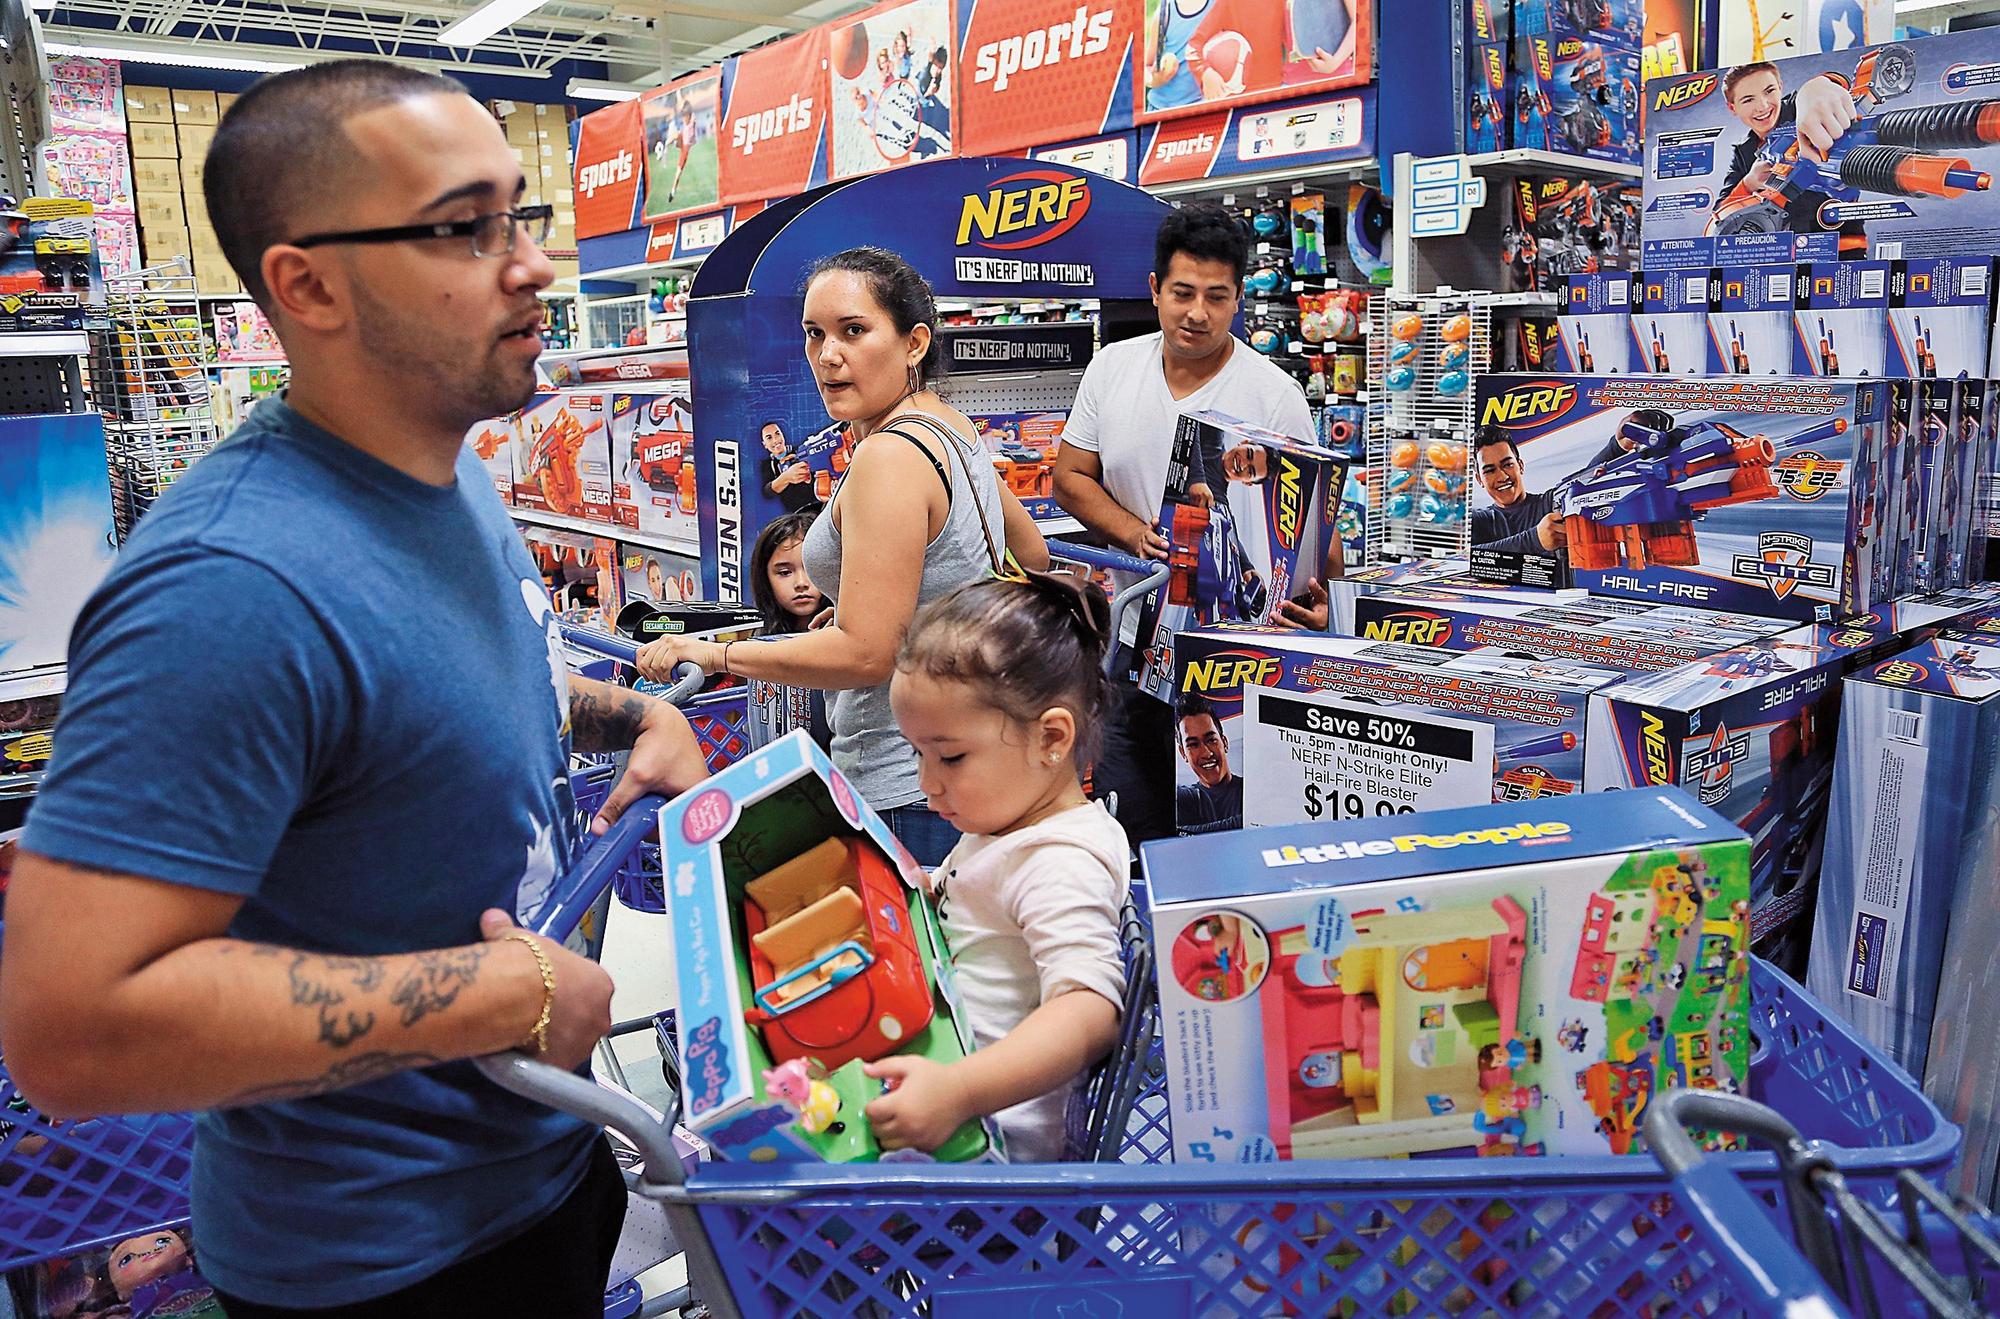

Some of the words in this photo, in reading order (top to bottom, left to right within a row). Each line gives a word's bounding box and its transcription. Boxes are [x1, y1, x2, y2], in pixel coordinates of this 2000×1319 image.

[974, 4, 1113, 92] sports
[1535, 38, 1551, 81] NERF
[1557, 41, 1583, 57] NERF
[1488, 48, 1502, 89] NERF
[1654, 74, 1718, 111] NERF
[732, 93, 813, 156] sports
[1155, 132, 1214, 162] sports
[579, 149, 633, 199] sports
[1542, 180, 1568, 198] NERF
[955, 177, 1089, 247] NERF
[1520, 181, 1535, 222] NERF
[1661, 240, 1695, 250] ATTENTION:
[1735, 234, 1777, 245] PRECAUCIÓN:
[958, 259, 982, 280] IT'S
[986, 261, 1021, 281] NERF
[1023, 264, 1039, 280] OR
[1041, 263, 1093, 285] NOTHIN'!
[30, 297, 75, 305] NITRO
[955, 340, 977, 358] IT'S
[979, 342, 1009, 359] NERF
[1011, 343, 1024, 359] OR
[1026, 343, 1070, 360] NOTHIN'!
[1525, 323, 1541, 364] NERF
[616, 364, 652, 379] MEGA
[1605, 381, 1648, 391] HIGHEST
[1650, 383, 1702, 392] CAPACITY
[1703, 384, 1734, 392] NERF
[1741, 385, 1796, 394] BLASTER
[1797, 387, 1831, 395] EVER
[614, 396, 632, 414] NERF
[1480, 384, 1576, 426] NERF
[1592, 399, 1604, 407] EL
[1685, 401, 1714, 411] NERF
[1716, 403, 1739, 412] CON
[1741, 403, 1765, 413] MÁS
[1766, 405, 1834, 416] CAPACIDAD
[1602, 390, 1672, 400] FOUDROYEUR
[1674, 391, 1703, 401] NERF
[1703, 391, 1712, 401] À
[1713, 393, 1770, 403] CAPACITÉ
[1771, 394, 1847, 406] SUPÉRIEURE
[644, 440, 681, 464] MEGA
[809, 440, 837, 456] ELITE
[717, 447, 736, 508] IT'S
[1327, 465, 1342, 523] NERF
[1773, 469, 1798, 484] 75
[583, 490, 611, 506] MEGA
[1279, 456, 1301, 550] NERF
[1572, 490, 1621, 506] HAIL-FIRE
[1592, 505, 1614, 520] NERF
[1762, 534, 1809, 548] N-STRIKE
[625, 555, 643, 570] NERF
[718, 518, 741, 602] NERF
[1738, 561, 1830, 581] ELITE
[1601, 574, 1709, 600] HAIL-FIRE
[645, 622, 664, 630] SESAME
[1363, 617, 1451, 645] NERF
[1462, 625, 1476, 634] LE
[1477, 628, 1543, 644] FOUDROYEUR
[1544, 639, 1572, 649] NERF
[1575, 641, 1583, 650] À
[1584, 643, 1637, 660] CAPACITÉ
[1479, 619, 1521, 630] HIGHEST
[1522, 624, 1574, 639] CAPACITY
[1576, 631, 1603, 643] NERF
[1610, 638, 1664, 654] BLASTER
[1666, 647, 1697, 658] EVER
[1149, 629, 1167, 689] ELITE
[1464, 635, 1477, 643] EL
[1554, 649, 1583, 661] NERF
[1584, 653, 1607, 664] CON
[1609, 655, 1633, 669] MÁS
[1182, 656, 1281, 693] NERF
[1312, 659, 1359, 672] HIGHEST
[1361, 665, 1417, 681] CAPACITY
[1419, 675, 1452, 686] NERF
[1459, 681, 1519, 697] BLASTER
[1521, 690, 1557, 703] EVER
[1875, 660, 1917, 685] NERF
[1293, 666, 1308, 675] LE
[1309, 669, 1383, 687] FOUDROYEUR
[1385, 680, 1417, 692] NERF
[1420, 682, 1428, 694] À
[1430, 686, 1490, 704] CAPACITÉ
[1492, 696, 1574, 717] SUPÉRIEURE
[1297, 677, 1312, 686] EL
[1398, 693, 1430, 706] NERF
[1431, 700, 1457, 711] CON
[1458, 703, 1485, 715] MÁS
[1487, 708, 1561, 727] CAPACIDAD
[1764, 672, 1828, 710] HAIL-FIRE
[1306, 708, 1360, 737] Save
[1367, 719, 1416, 748] 50%
[1278, 729, 1305, 746] Thu.
[1308, 735, 1336, 752] 5pm
[1349, 743, 1406, 767] Midnight
[1411, 755, 1448, 773] Only!
[1641, 710, 1668, 784] NER
[1689, 741, 1748, 773] ELITE
[1291, 747, 1332, 767] NERF
[1337, 757, 1395, 779] N-Strike
[1400, 769, 1433, 788] Elite
[1304, 766, 1362, 790] Hail-Fire
[1367, 780, 1418, 801] Blaster
[1495, 781, 1524, 801] 75
[1260, 839, 1394, 868] Little
[1392, 821, 1571, 852] People
[687, 1017, 720, 1061] Pig
[691, 1049, 727, 1112] Peppa
